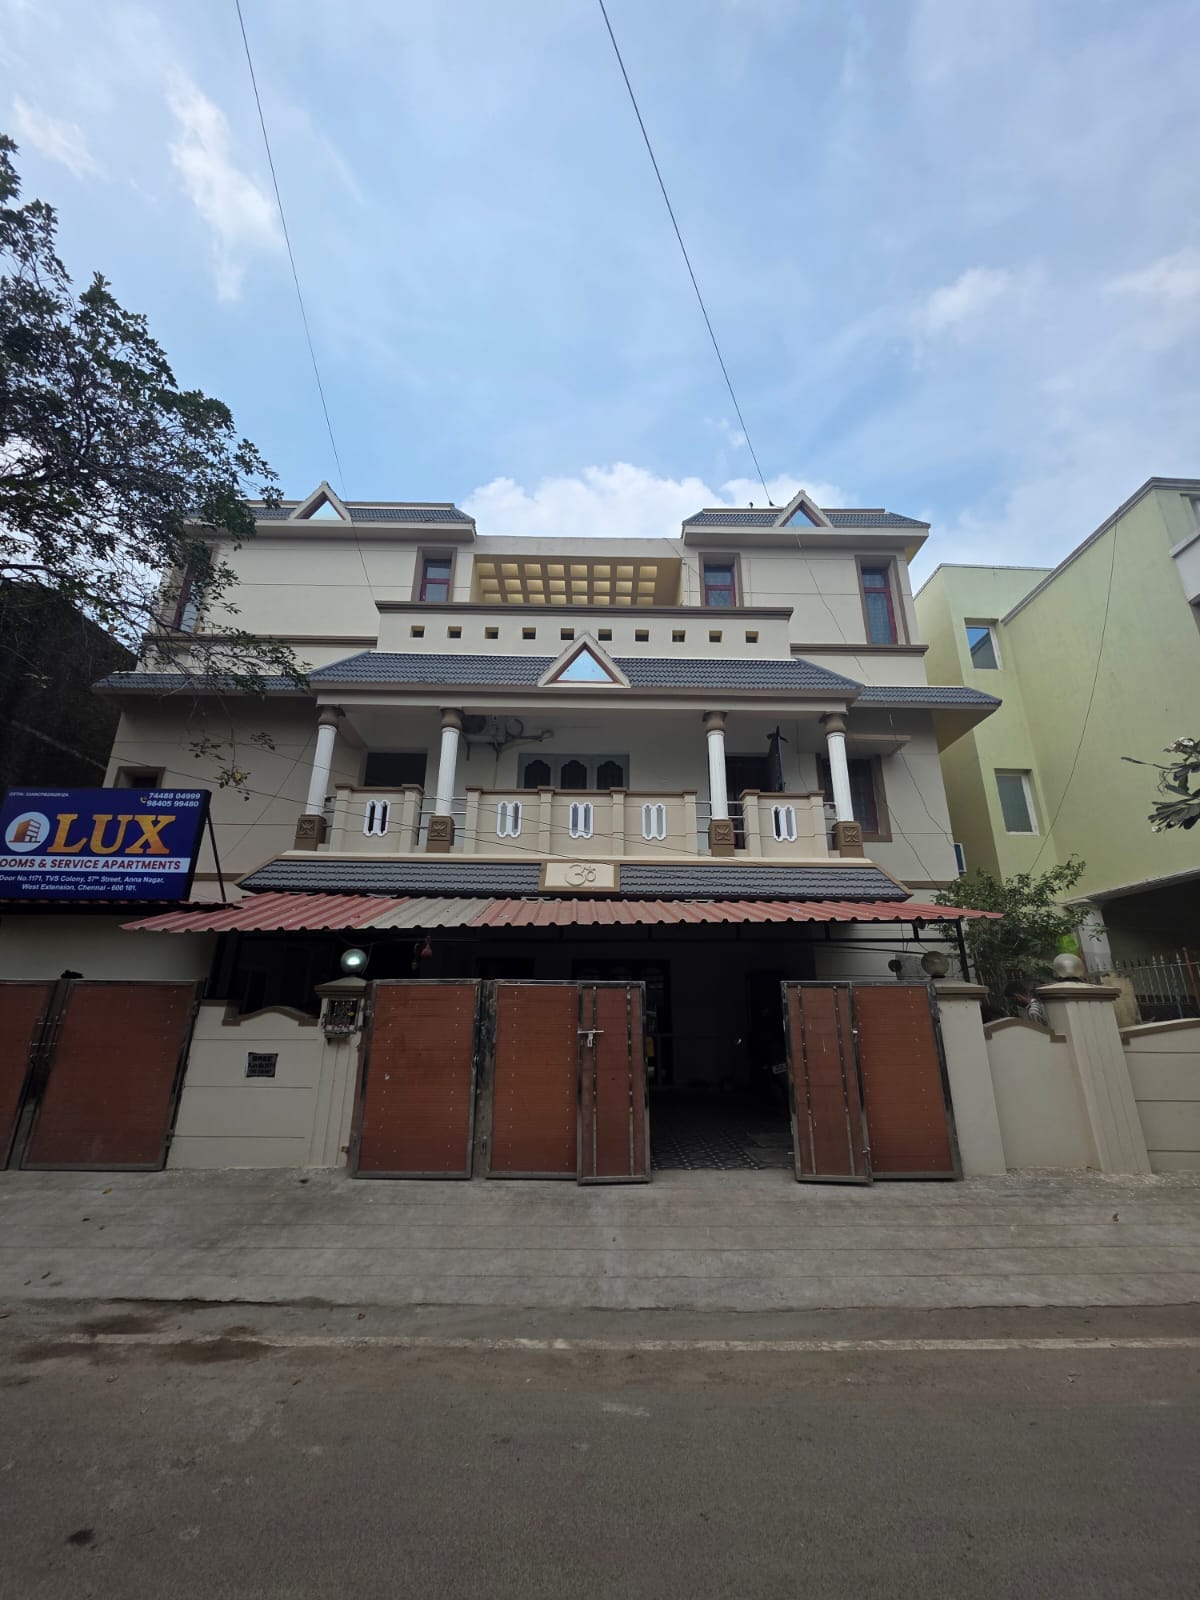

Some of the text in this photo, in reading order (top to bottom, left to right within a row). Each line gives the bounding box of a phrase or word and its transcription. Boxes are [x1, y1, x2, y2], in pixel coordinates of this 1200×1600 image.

[175, 792, 201, 800] 04999
[46, 813, 176, 855] LUX
[0, 858, 182, 870] OOMS & SERVICE APARTMENTS
